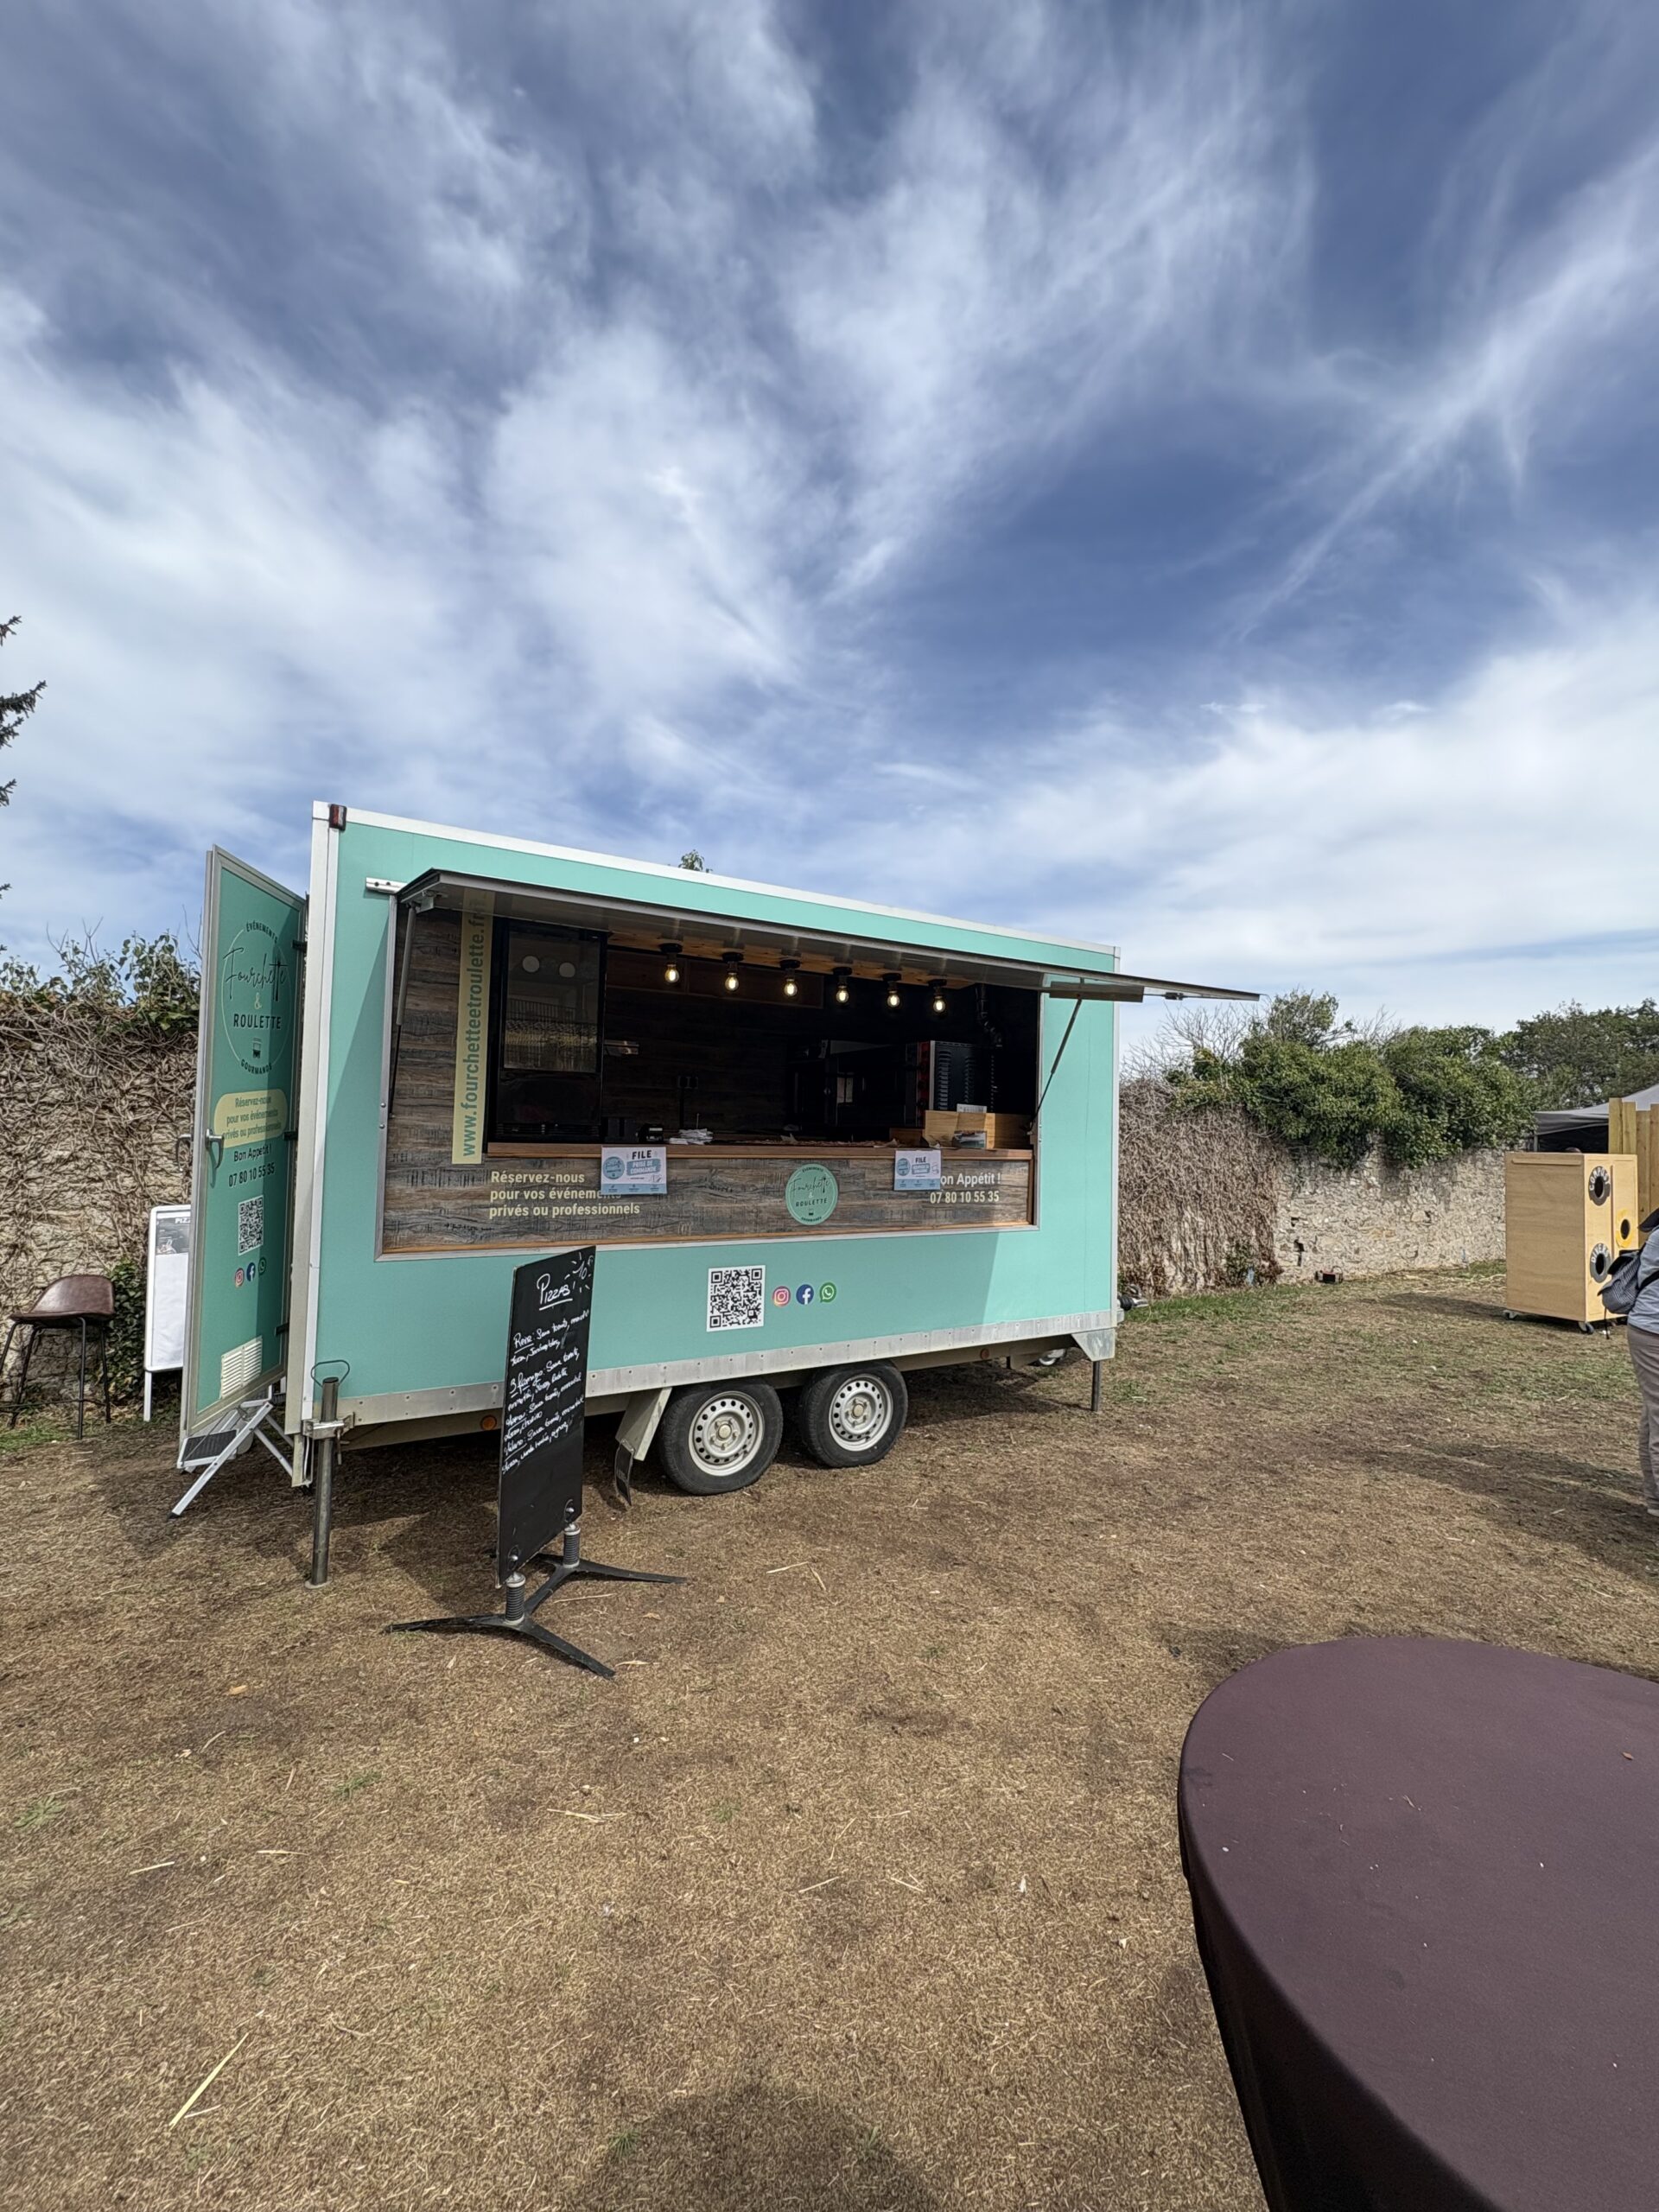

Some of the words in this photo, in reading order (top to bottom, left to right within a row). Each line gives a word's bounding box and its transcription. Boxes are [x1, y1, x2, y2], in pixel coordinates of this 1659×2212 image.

[223, 947, 289, 1001] Fourchette
[254, 992, 262, 1010] &
[233, 1014, 281, 1029] ROULETTE
[226, 1115, 238, 1128] pour
[240, 1113, 250, 1122] vos
[234, 1150, 246, 1162] Bon
[632, 1150, 652, 1160] FILE
[229, 1173, 238, 1187] 07
[239, 1170, 247, 1184] 80
[249, 1167, 257, 1180] 10
[258, 1165, 266, 1178] 55
[267, 1162, 275, 1175] 35
[491, 1170, 585, 1184] Réservez-nous
[940, 1175, 954, 1186] on
[957, 1172, 995, 1188] Appétit
[490, 1190, 523, 1203] pour
[524, 1190, 545, 1200] vos
[796, 1198, 827, 1207] ROULETTE
[930, 1192, 942, 1204] 07
[944, 1192, 957, 1204] 80
[960, 1192, 971, 1204] 10
[974, 1191, 985, 1203] 55
[988, 1191, 1000, 1202] 35
[489, 1205, 529, 1219] privés
[533, 1206, 548, 1216] ou
[552, 1202, 640, 1218] professionnels
